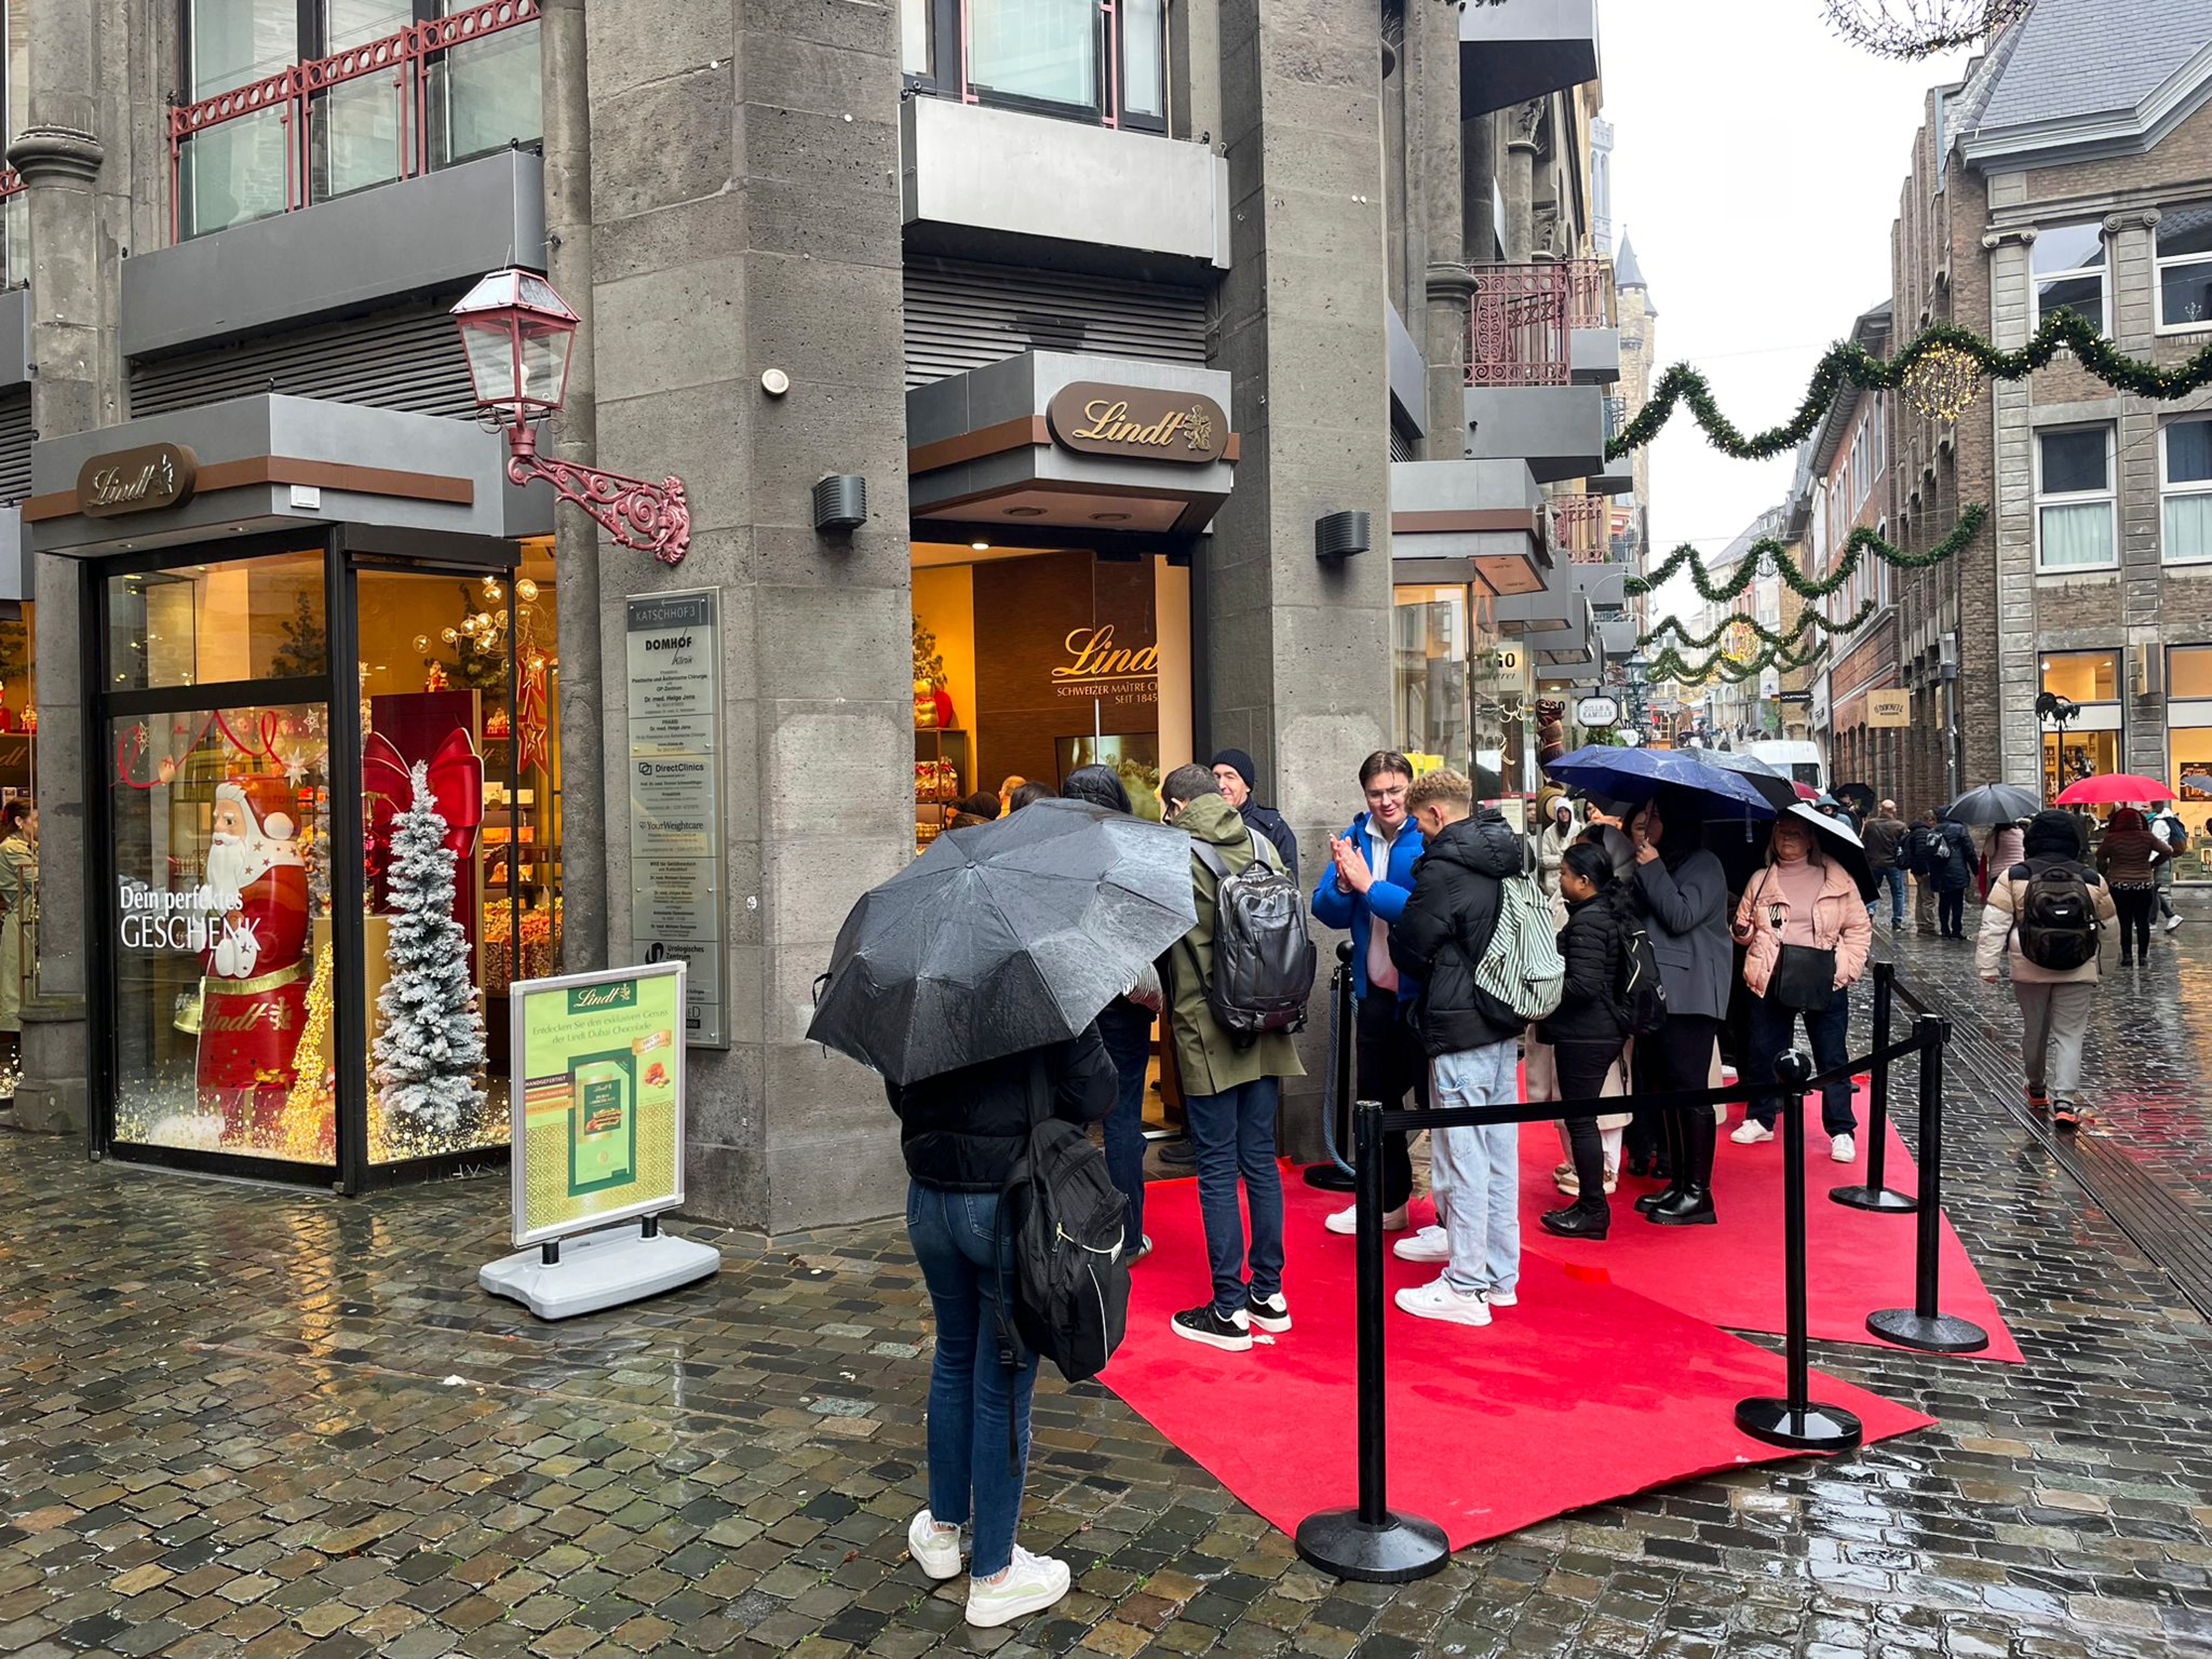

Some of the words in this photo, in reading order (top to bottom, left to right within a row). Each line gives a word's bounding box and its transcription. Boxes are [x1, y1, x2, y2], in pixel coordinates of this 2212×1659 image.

[1072, 400, 1185, 446] Lindt
[86, 465, 154, 505] Lindt
[636, 606, 689, 621] KATSCHHOF
[690, 606, 695, 617] 3
[646, 636, 692, 651] DOMHOF
[1052, 624, 1158, 676] Lind
[675, 656, 693, 665] Klinik
[1057, 686, 1109, 697] SCHWEIZER
[1111, 681, 1145, 694] MAÎTRE
[1115, 694, 1133, 705] SEIT
[1137, 693, 1157, 703] 1845
[655, 764, 704, 772] DirectClinics
[647, 821, 703, 831] YourWeightcare
[120, 885, 159, 909] Dein
[165, 884, 243, 917] perfektes
[121, 915, 261, 951] GESCHENK
[667, 945, 704, 954] Urologisches
[573, 987, 620, 1008] Lindt
[203, 1001, 267, 1031] Lindt
[533, 1023, 571, 1036] Entdecken
[574, 1020, 585, 1029] Sie
[587, 1019, 601, 1027] den
[604, 1013, 641, 1024] exklusiven
[553, 1035, 565, 1044] der
[588, 1028, 611, 1038] Dubai
[525, 1076, 566, 1086] HANDGEFERTIGT
